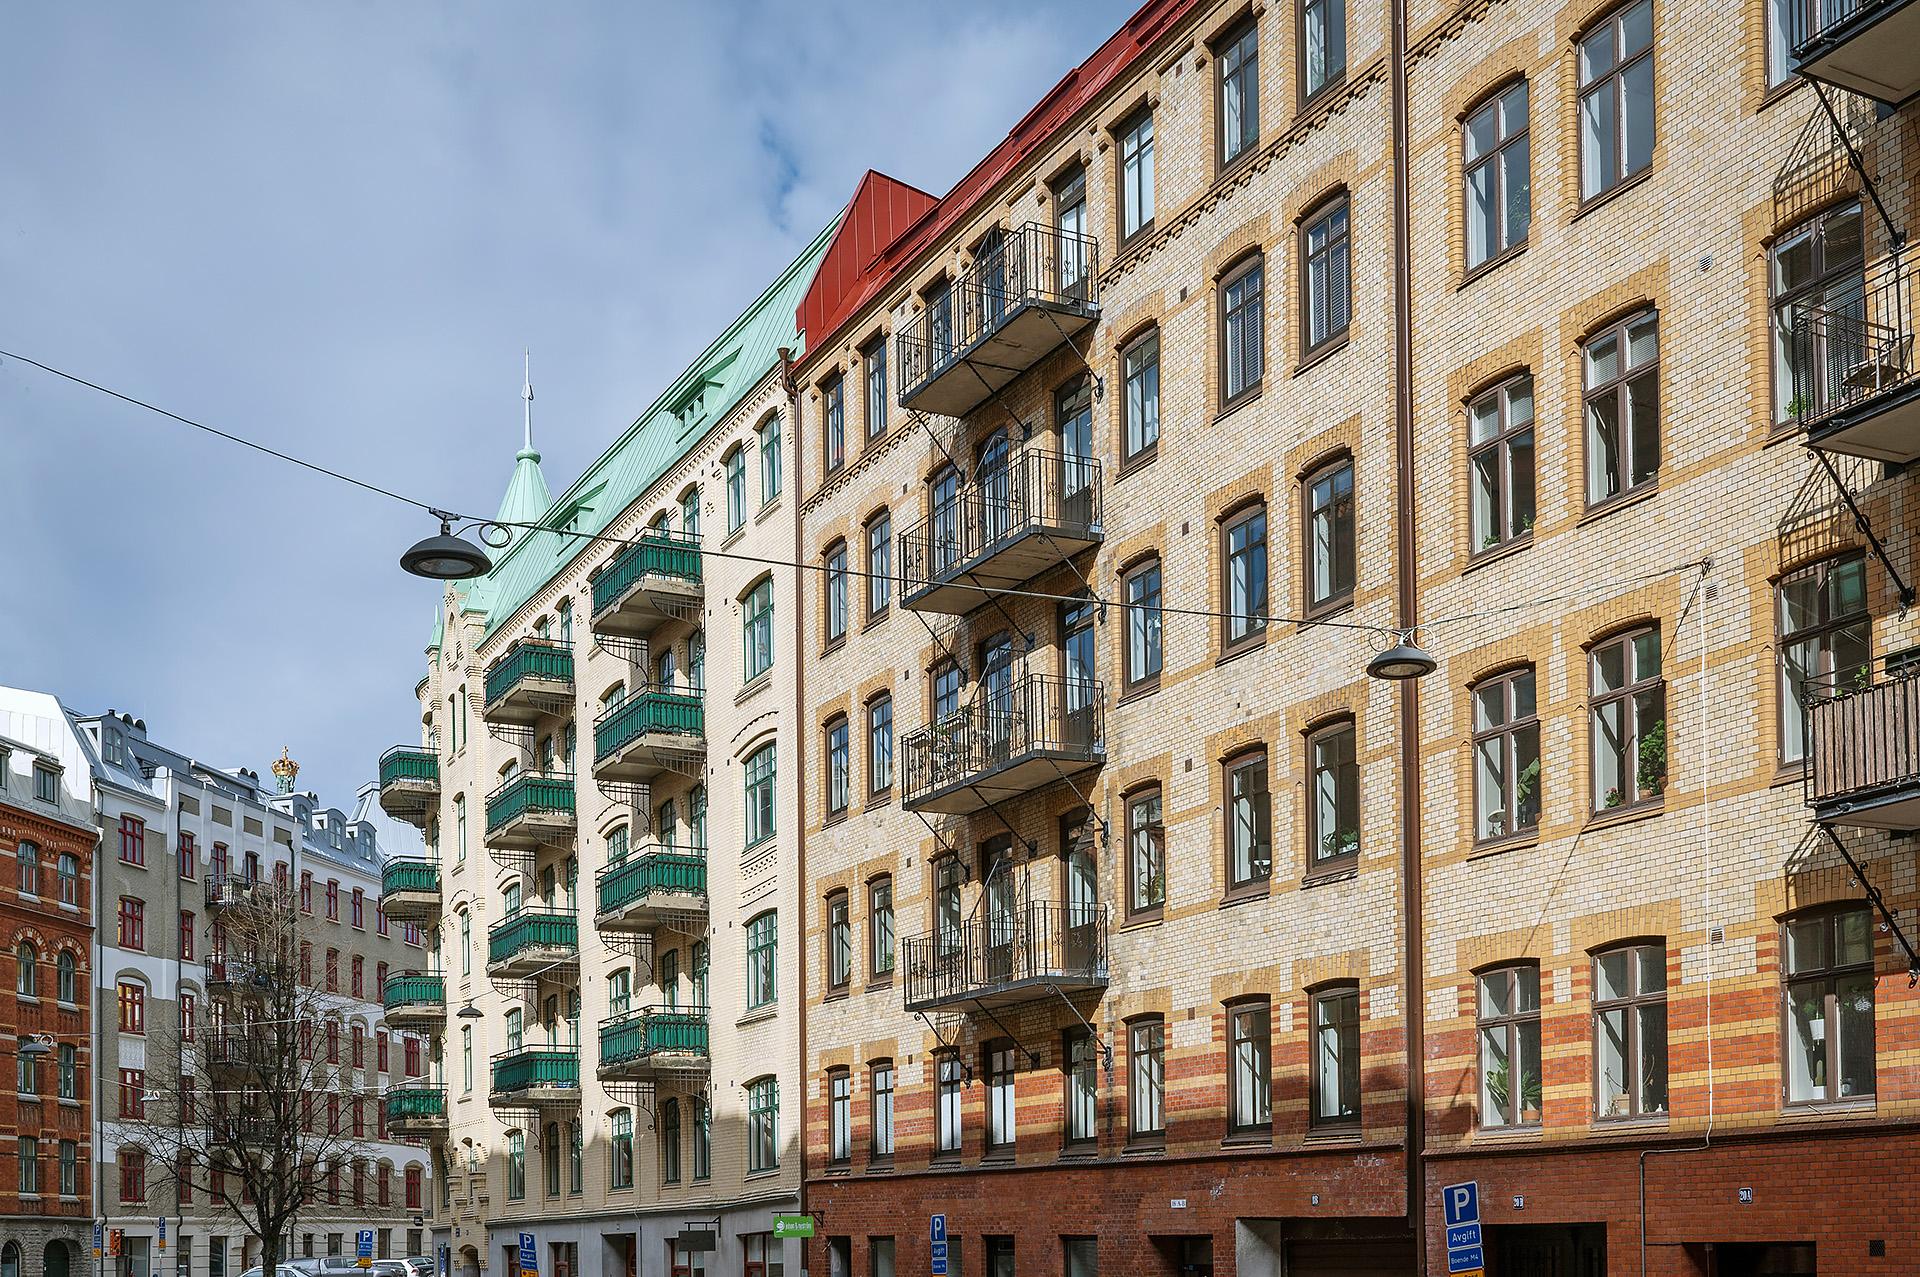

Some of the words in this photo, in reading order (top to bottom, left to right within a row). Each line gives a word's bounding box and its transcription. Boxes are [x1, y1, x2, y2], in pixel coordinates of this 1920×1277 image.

[1454, 1188, 1469, 1220] P
[62, 1223, 69, 1237] 9
[935, 1217, 942, 1240] P
[363, 1231, 371, 1242] P
[523, 1234, 532, 1249] P
[1452, 1230, 1476, 1243] Avgift
